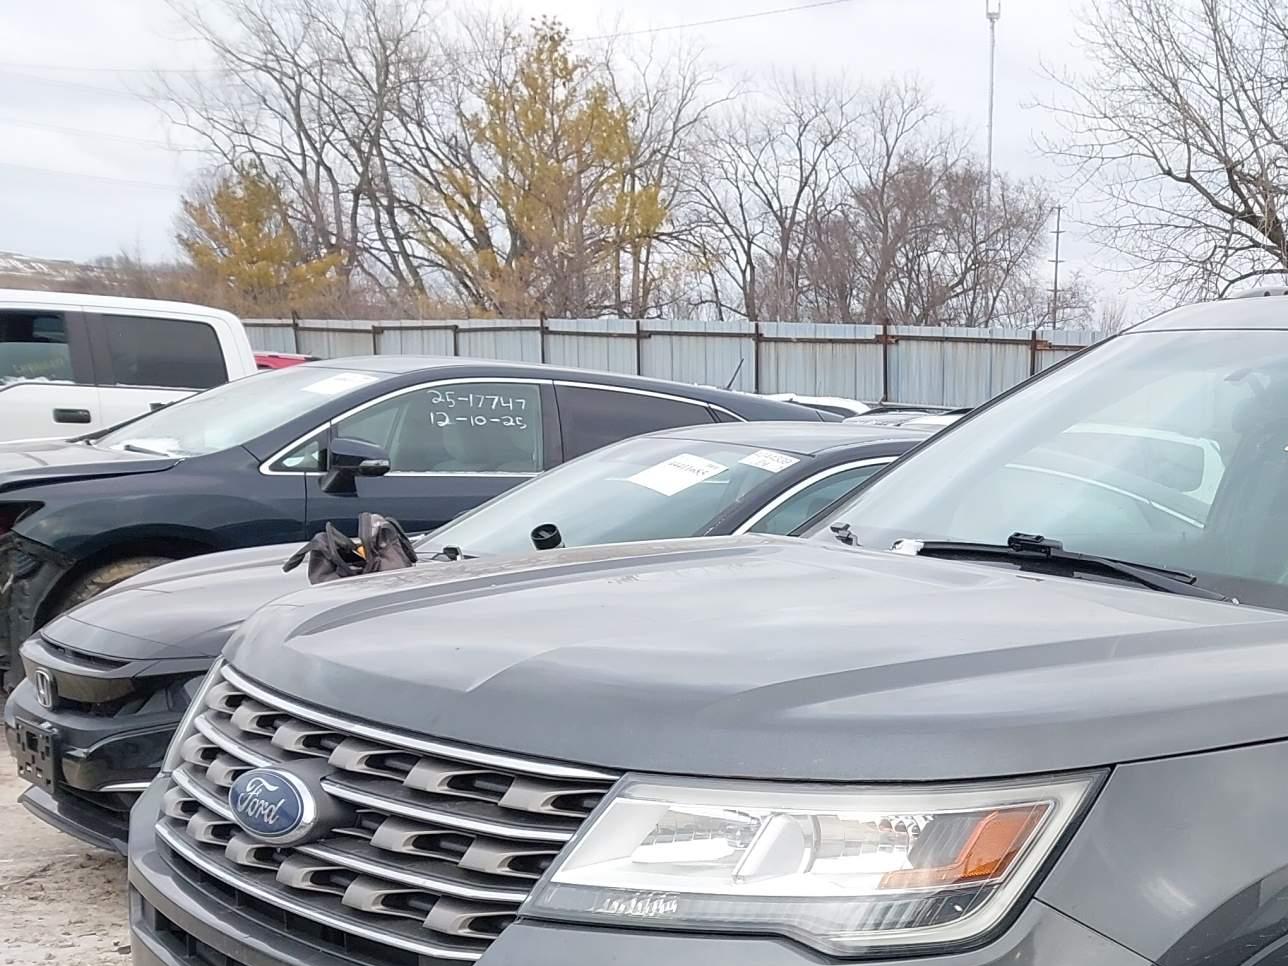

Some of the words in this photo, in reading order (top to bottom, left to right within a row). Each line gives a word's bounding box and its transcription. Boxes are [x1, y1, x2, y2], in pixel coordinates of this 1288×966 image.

[426, 390, 526, 411] 25-17747
[430, 411, 528, 429] 12-10-25
[238, 777, 285, 825] Ford
